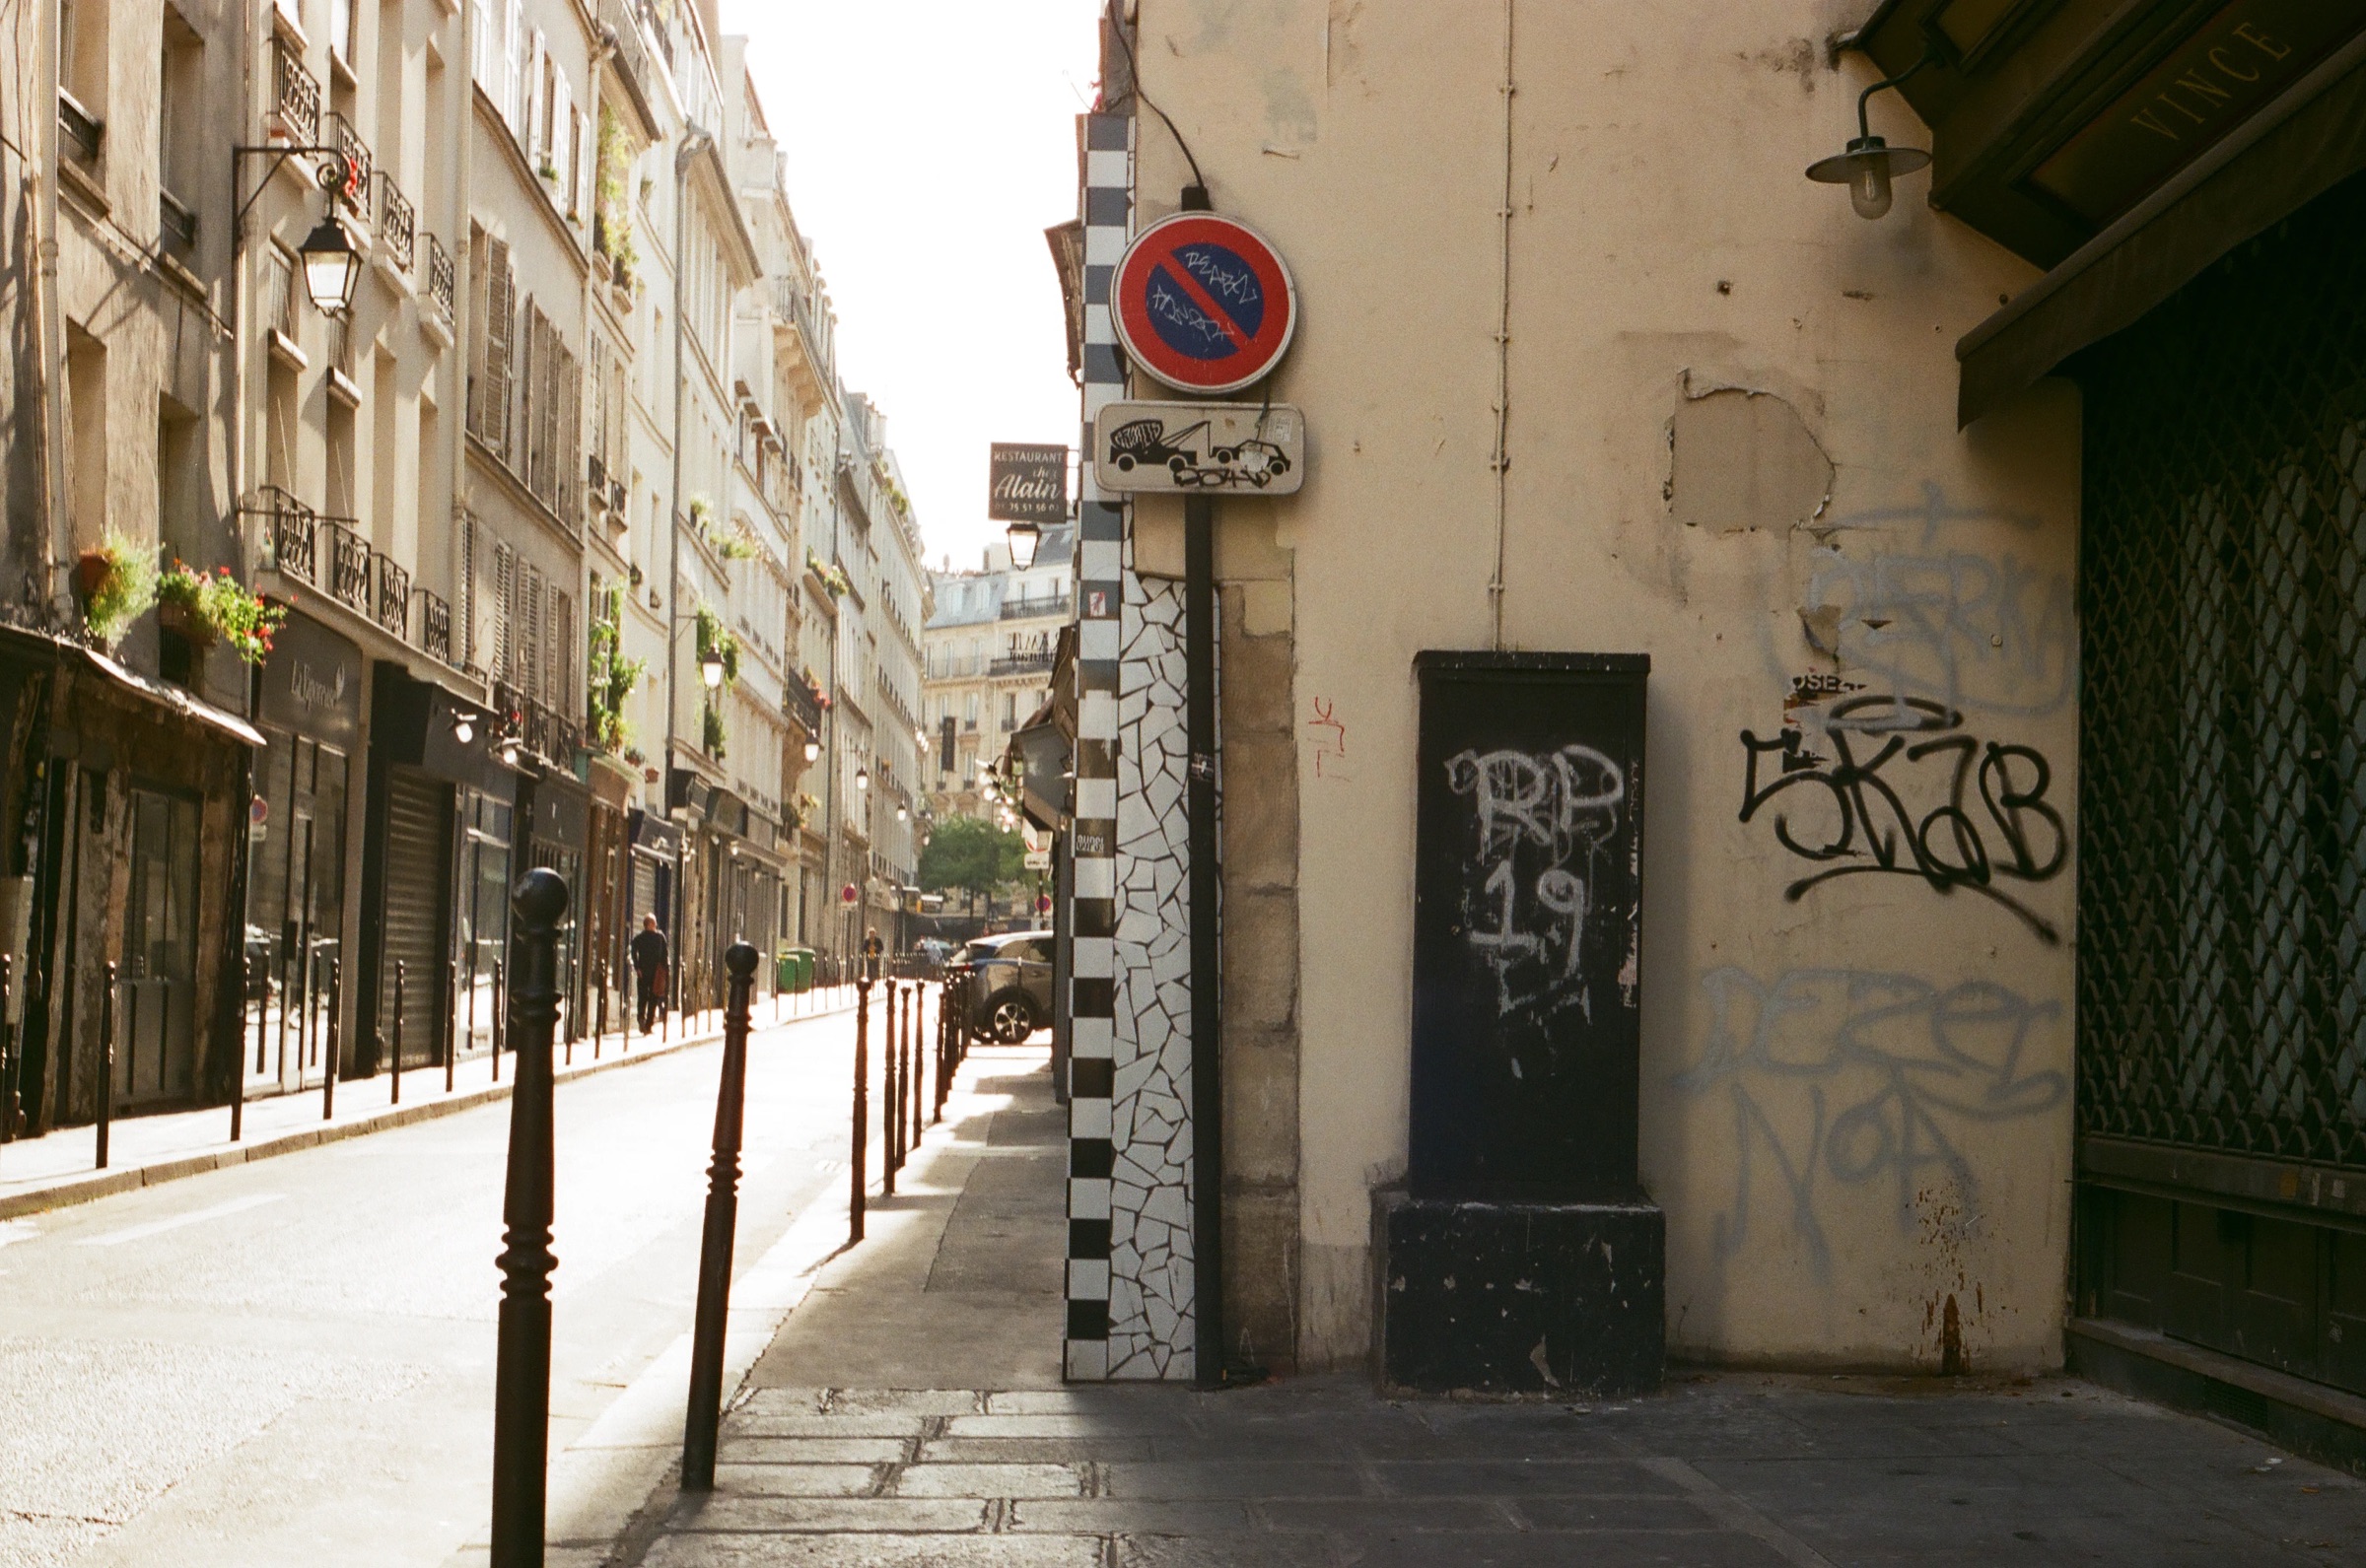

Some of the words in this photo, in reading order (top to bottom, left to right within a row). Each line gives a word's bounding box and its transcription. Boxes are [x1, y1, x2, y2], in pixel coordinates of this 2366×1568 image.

[2129, 22, 2292, 141] VINCE
[994, 451, 1063, 463] RESTAURANT
[994, 473, 1062, 500] Alain
